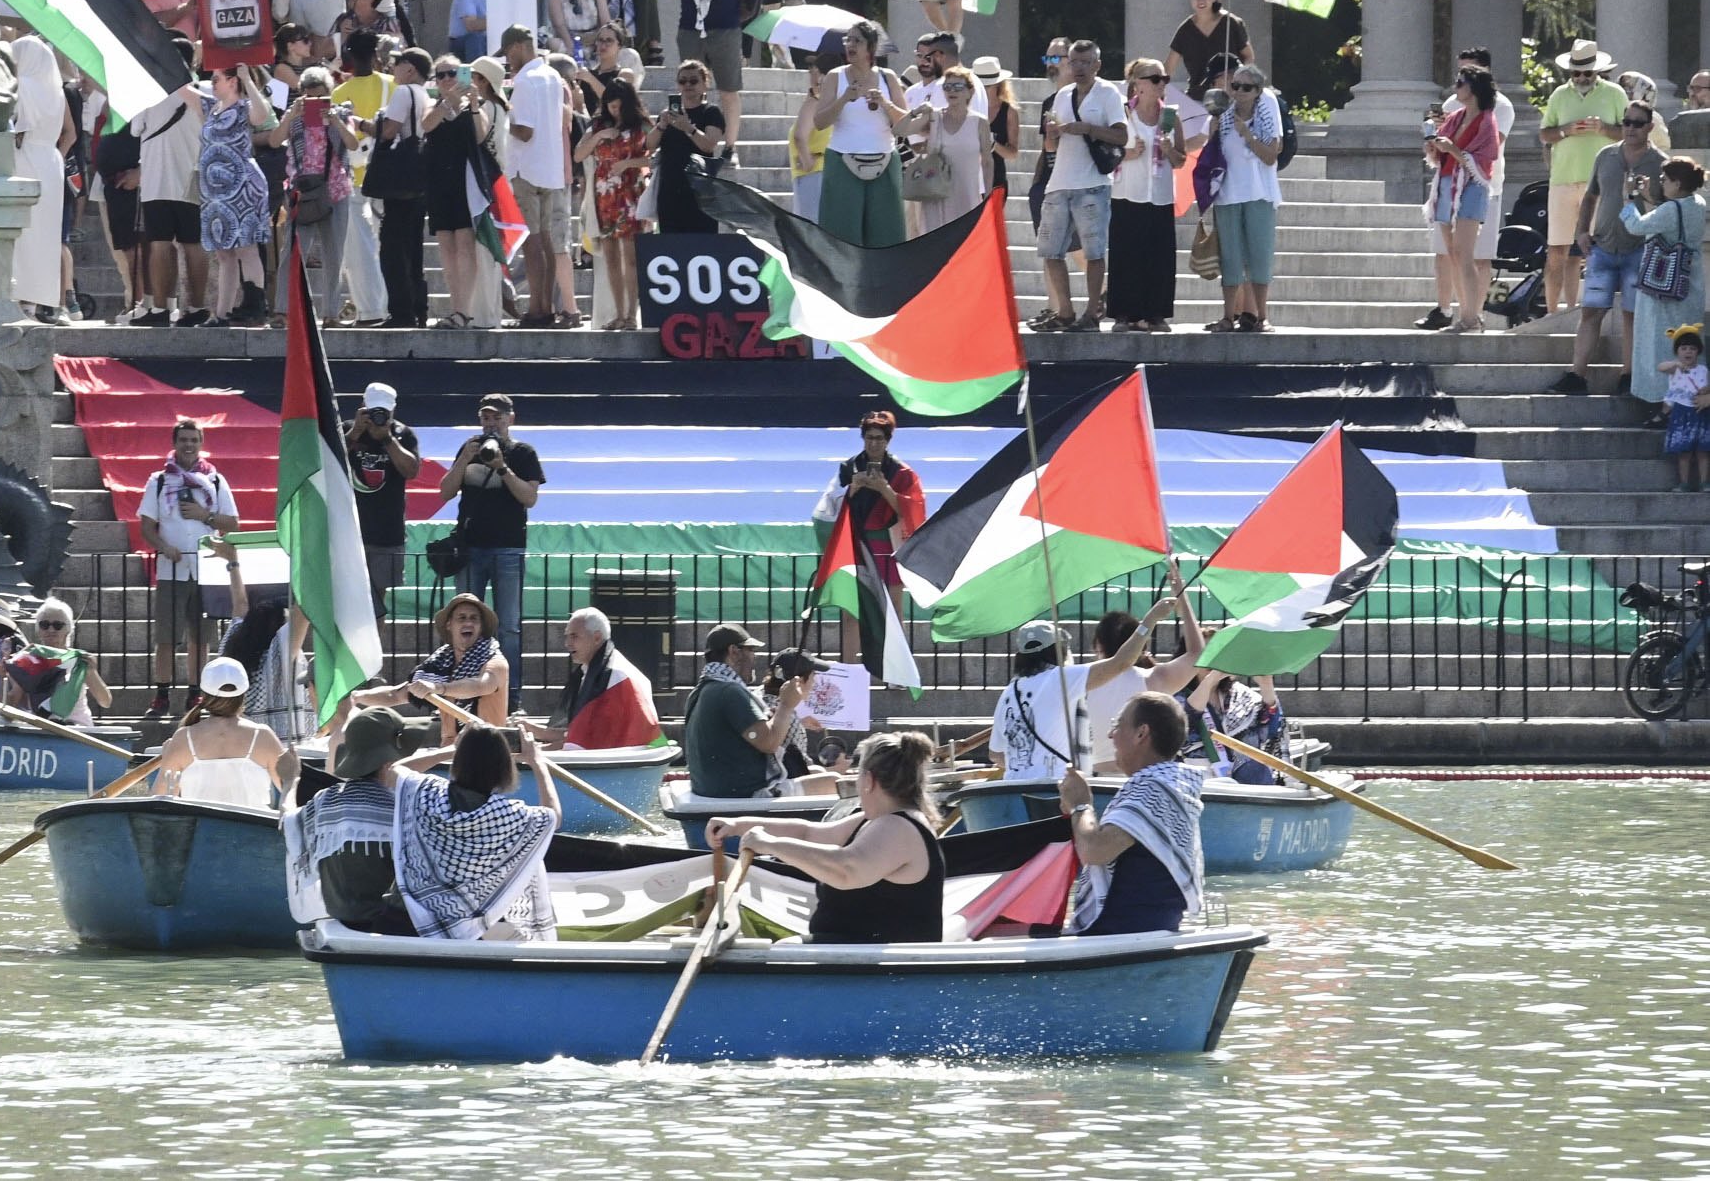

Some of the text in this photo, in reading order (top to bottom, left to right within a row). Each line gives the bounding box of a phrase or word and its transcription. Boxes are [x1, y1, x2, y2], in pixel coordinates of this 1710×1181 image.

[216, 8, 255, 24] GAZA
[647, 255, 761, 305] SOS
[1277, 818, 1329, 855] MADRID
